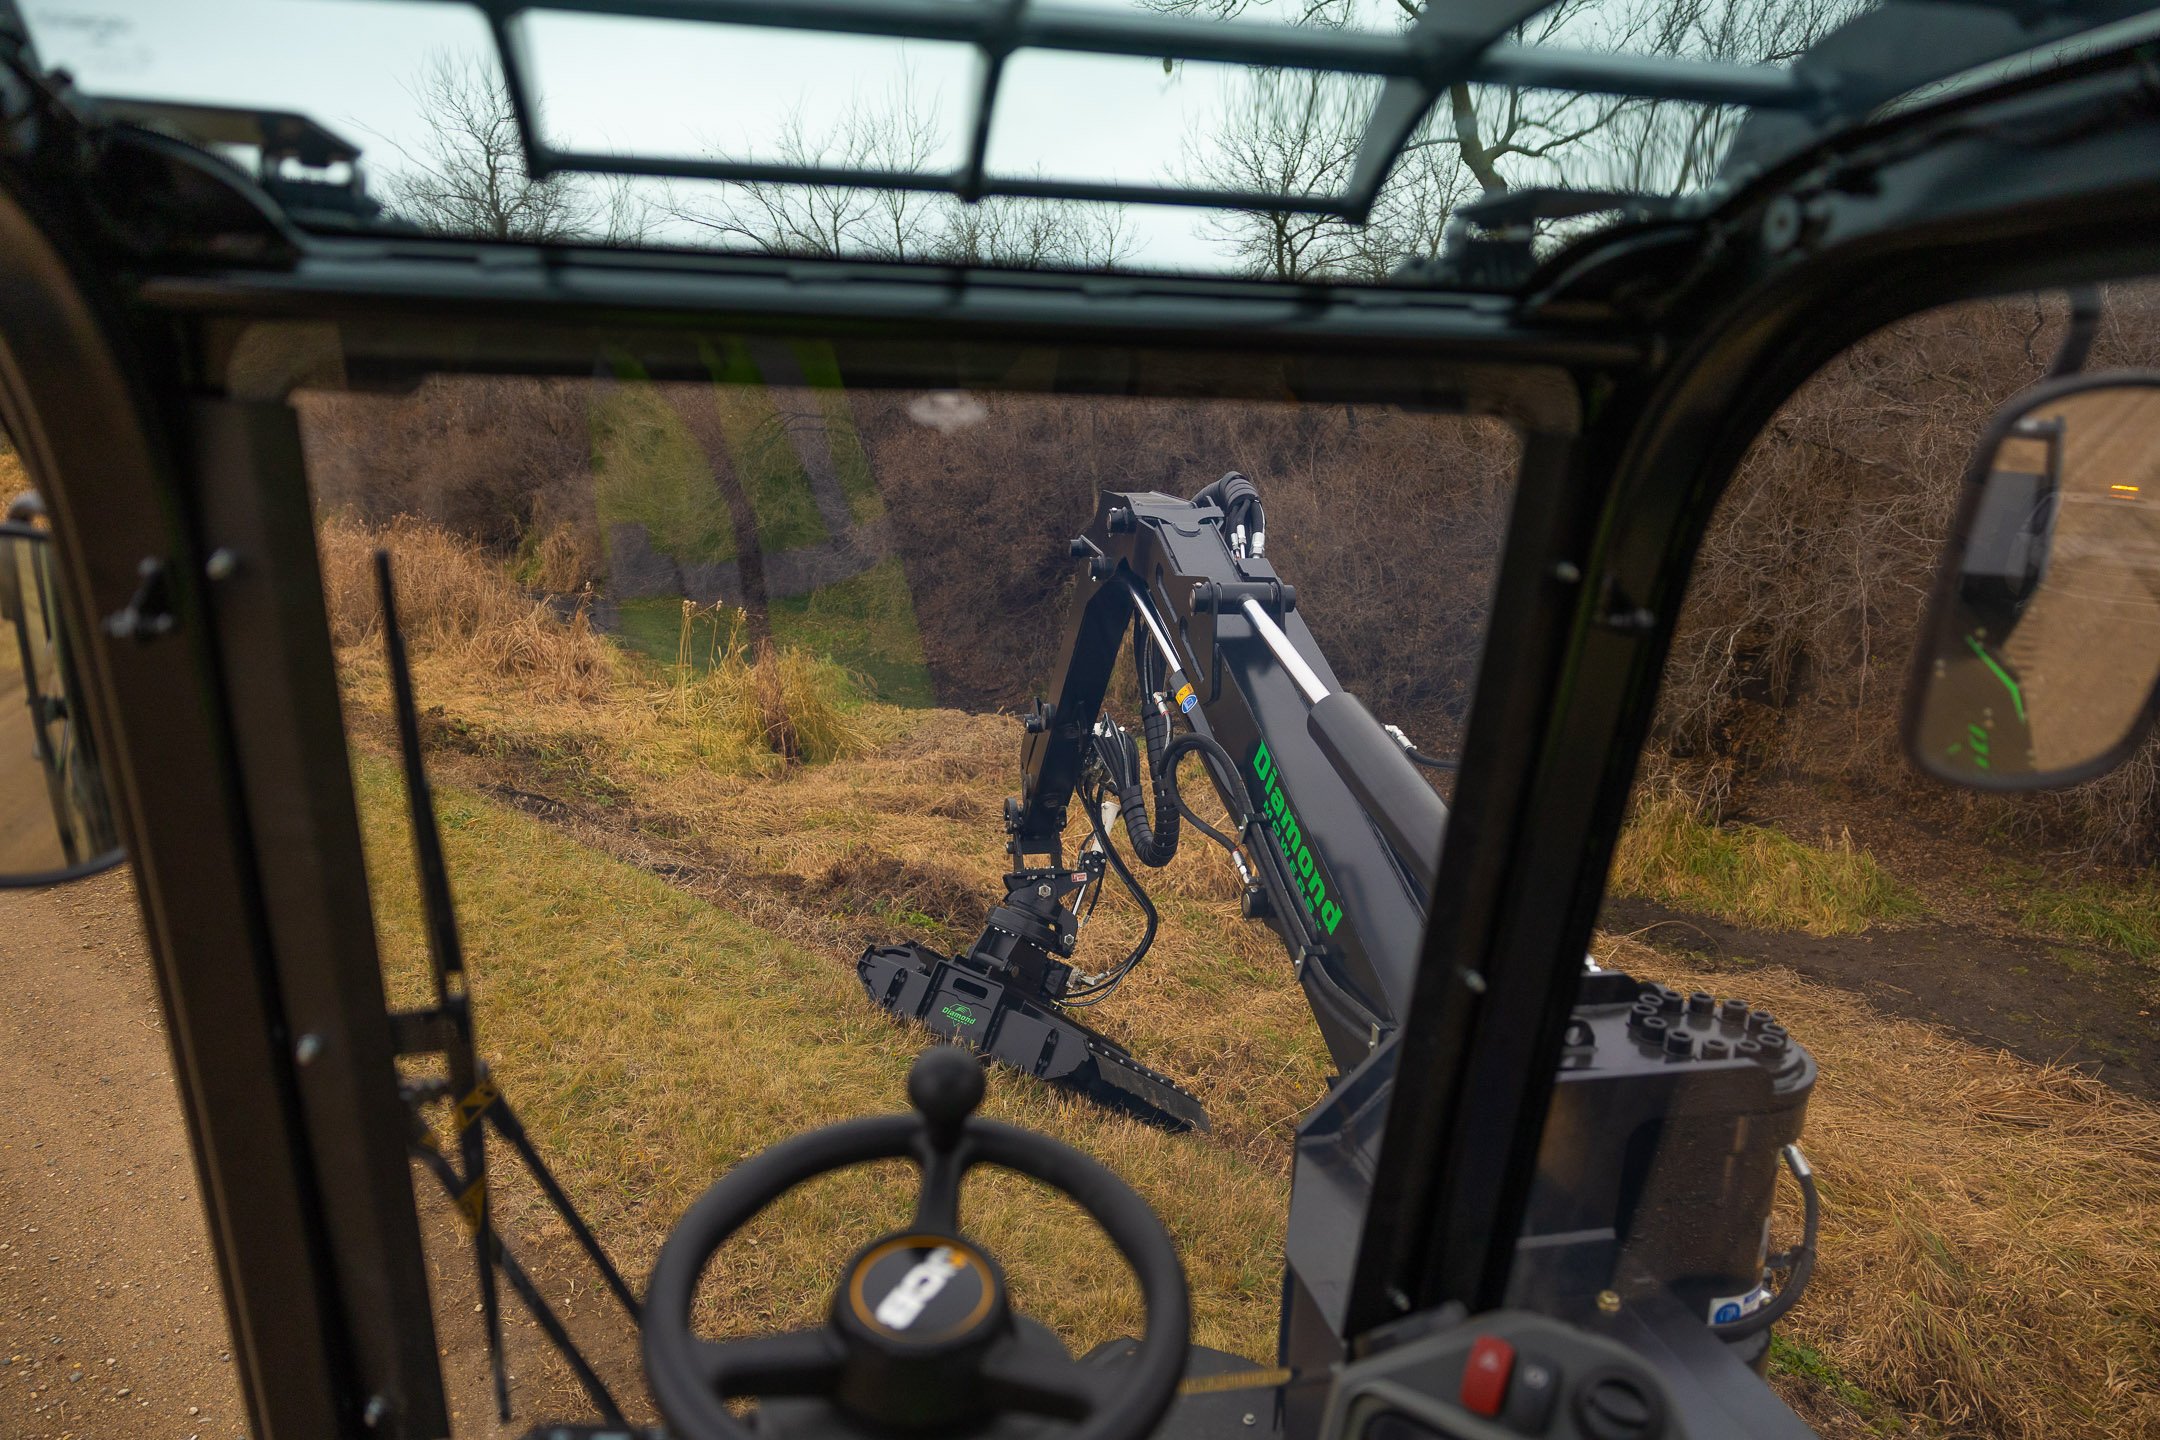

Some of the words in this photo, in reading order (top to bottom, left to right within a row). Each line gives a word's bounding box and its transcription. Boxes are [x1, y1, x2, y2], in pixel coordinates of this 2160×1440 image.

[1253, 739, 1343, 936] Diamond
[1264, 800, 1315, 914] MOWERS
[942, 1006, 977, 1025] Diamond
